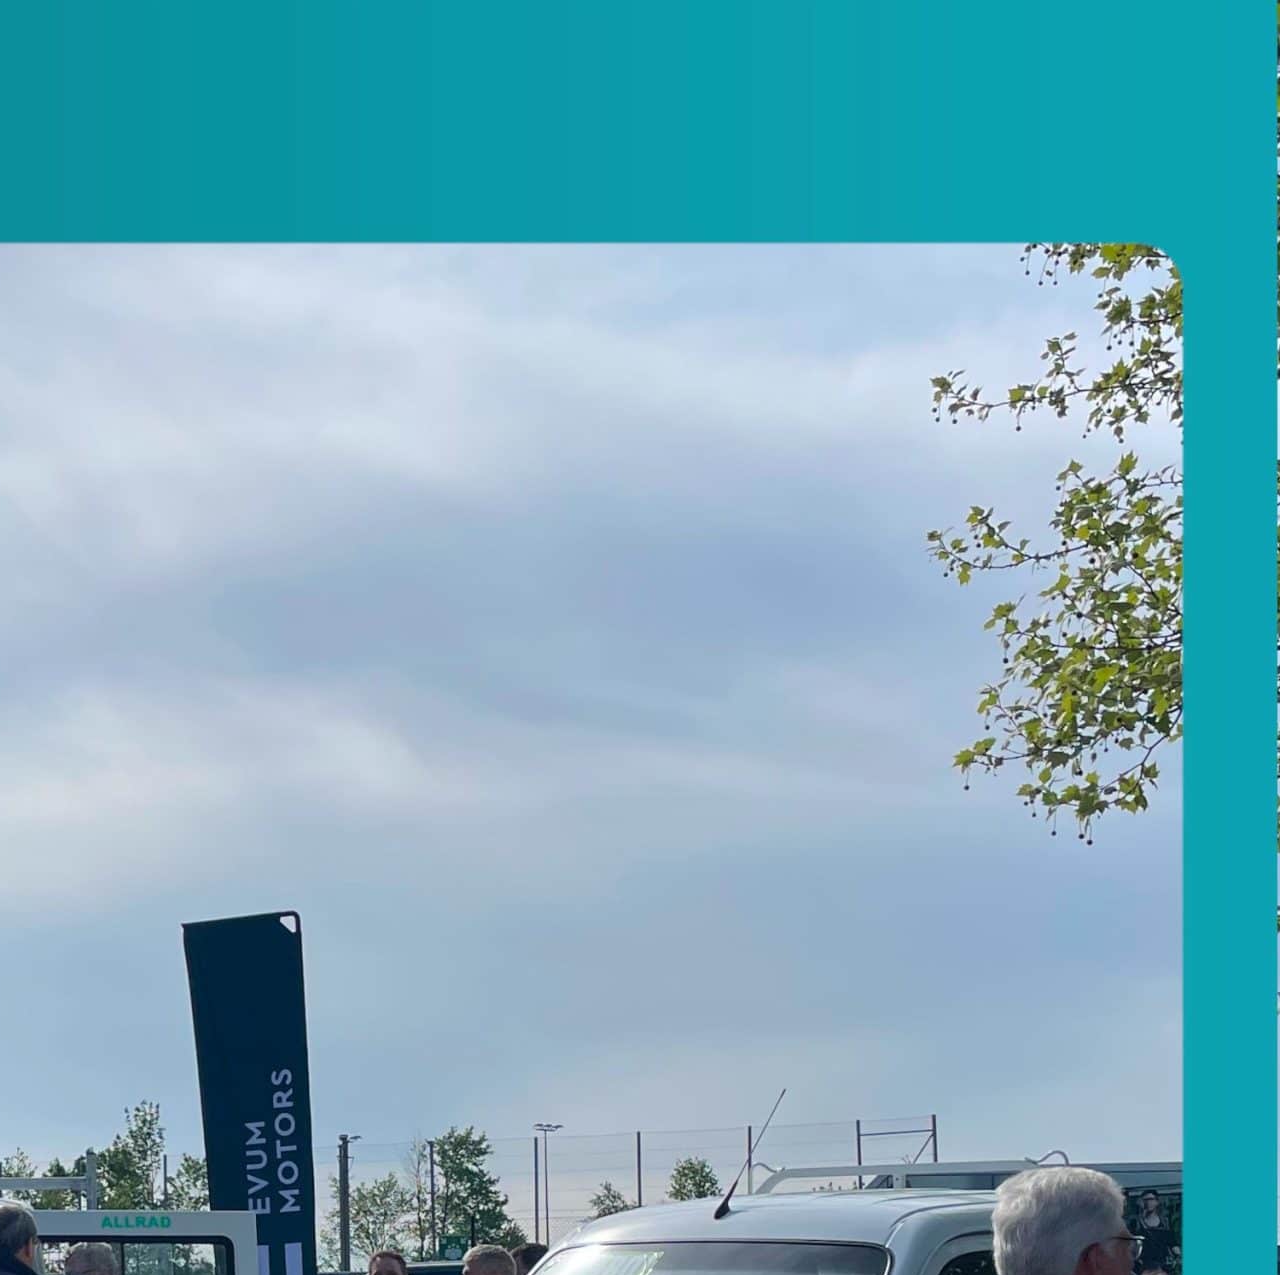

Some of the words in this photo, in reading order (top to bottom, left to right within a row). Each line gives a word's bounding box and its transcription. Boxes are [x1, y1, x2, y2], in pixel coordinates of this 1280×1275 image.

[245, 1121, 270, 1215] EVUM
[271, 1068, 301, 1213] MOTORS
[101, 1215, 171, 1229] ALLRAD
